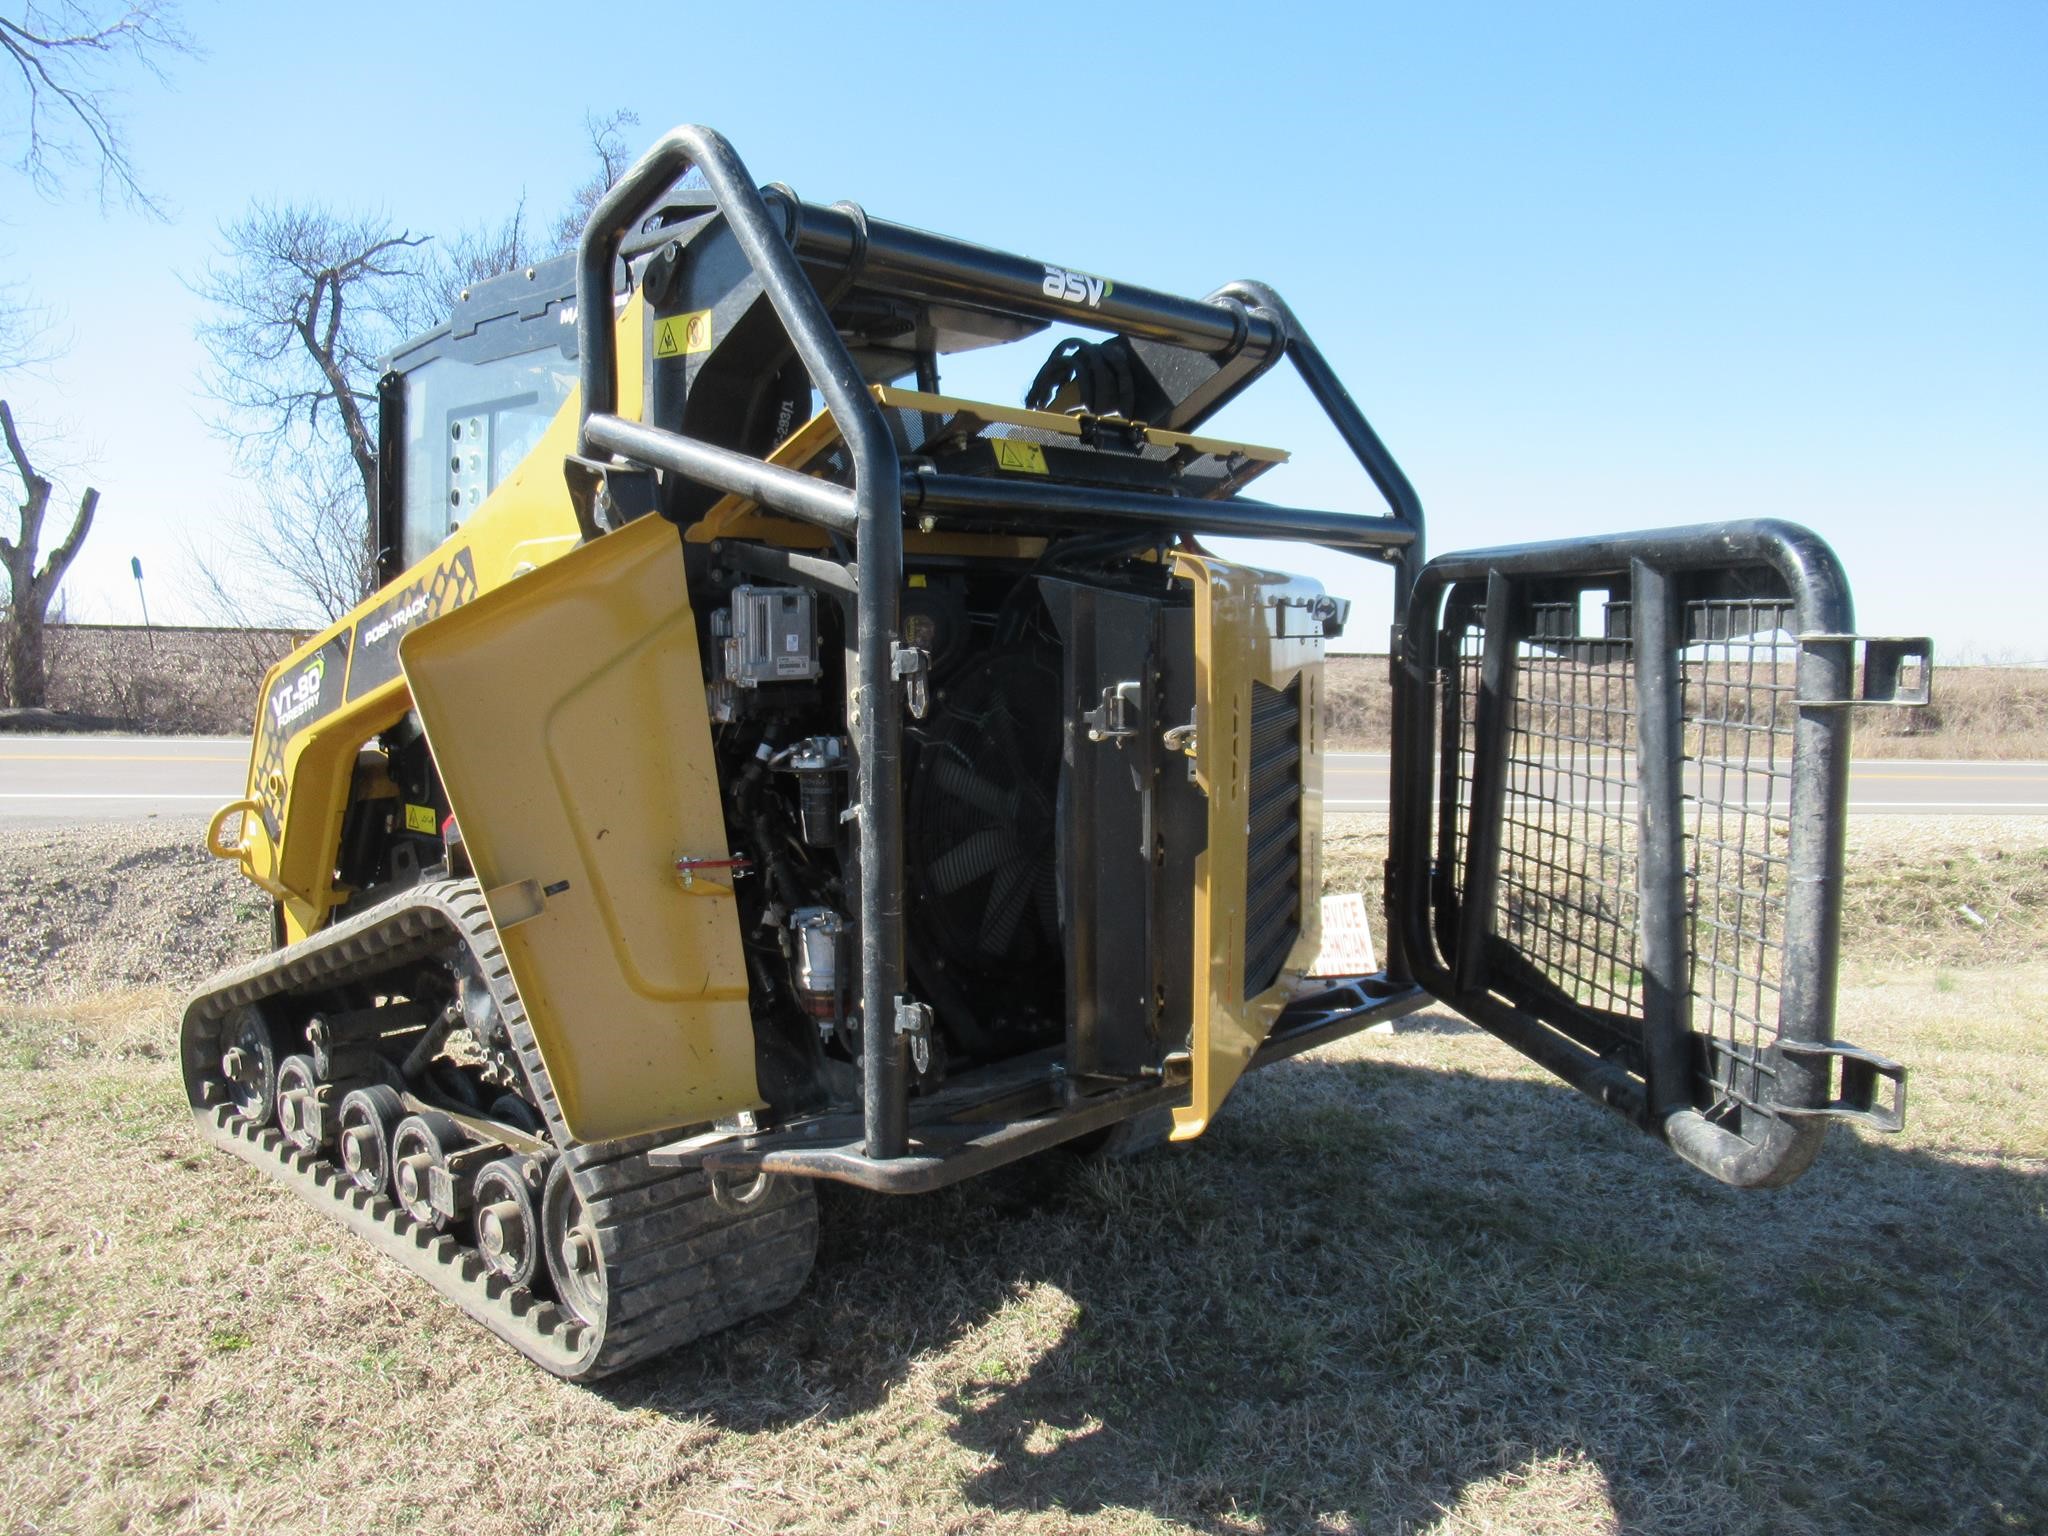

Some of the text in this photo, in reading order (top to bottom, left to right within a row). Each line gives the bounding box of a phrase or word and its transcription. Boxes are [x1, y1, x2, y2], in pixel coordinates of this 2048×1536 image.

[1042, 264, 1104, 309] asv
[364, 595, 429, 647] POSI-TRACK
[271, 667, 321, 716] VT-80
[277, 692, 320, 729] FORESTRY
